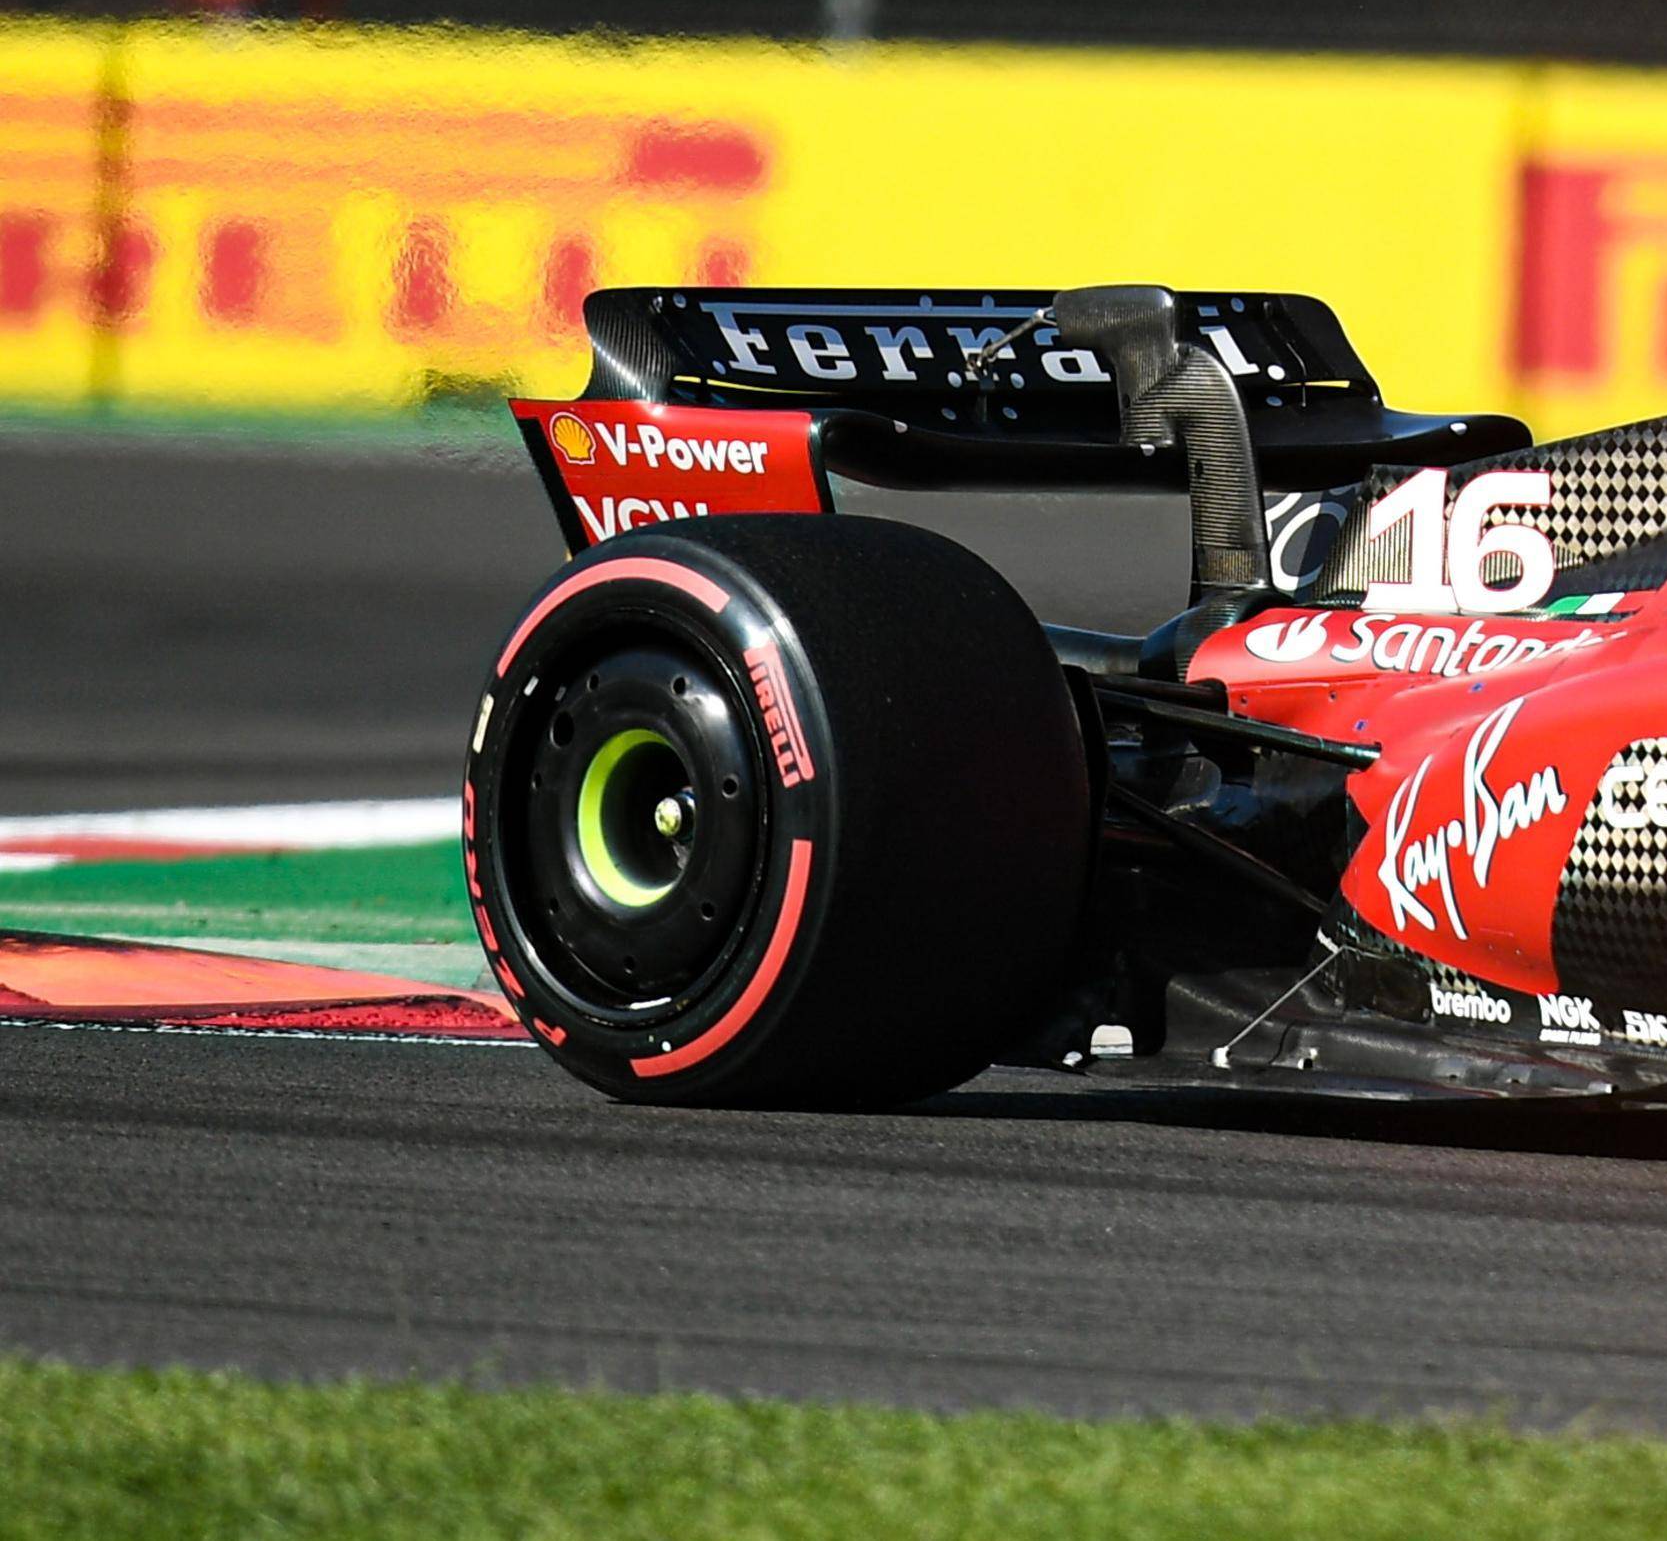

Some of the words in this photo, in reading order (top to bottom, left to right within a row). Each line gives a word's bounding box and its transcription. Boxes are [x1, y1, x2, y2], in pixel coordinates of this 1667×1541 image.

[702, 300, 1262, 382] Ferrai
[594, 422, 768, 474] V-Power
[1362, 466, 1556, 614] 16
[742, 643, 814, 789] PIRELLI
[1429, 982, 1512, 1024] brembo
[1536, 992, 1601, 1031] NGK
